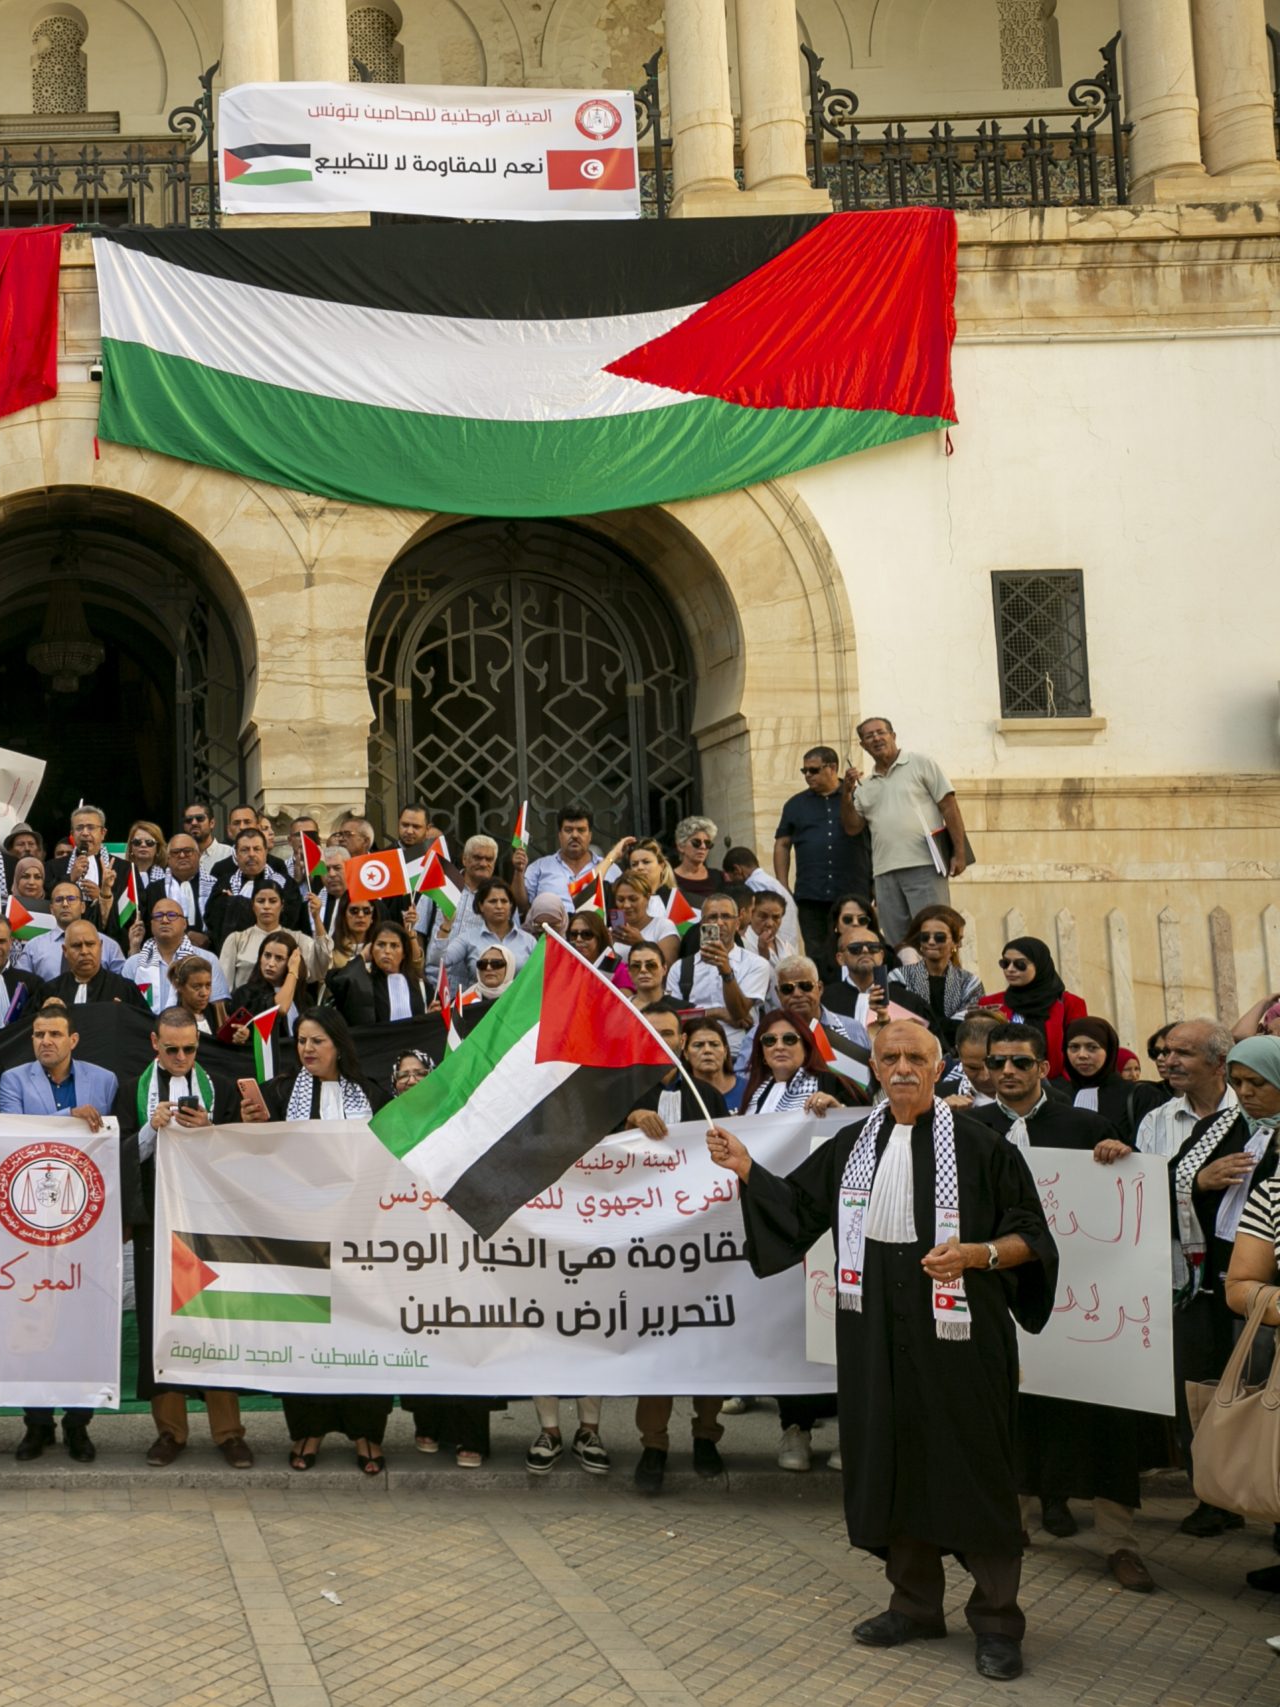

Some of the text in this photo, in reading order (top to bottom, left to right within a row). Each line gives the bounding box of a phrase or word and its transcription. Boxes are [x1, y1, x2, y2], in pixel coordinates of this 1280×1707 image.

[308, 103, 552, 126] الهيئة الوطنية للمحامين بتونس
[315, 152, 543, 178] نعم للمقاومة لا للتطبيع
[642, 1149, 688, 1174] الهيئة
[577, 1186, 662, 1224] الجهوي
[342, 1233, 448, 1272] الوحيد
[458, 1233, 547, 1273] الخيار
[558, 1246, 616, 1285] هي
[400, 1290, 736, 1338] لتحرير أرض فلسطين
[170, 1341, 240, 1364] للمقاومة
[244, 1345, 293, 1367] المجد
[311, 1347, 379, 1368] فلسطين
[383, 1348, 430, 1368] عاشت
